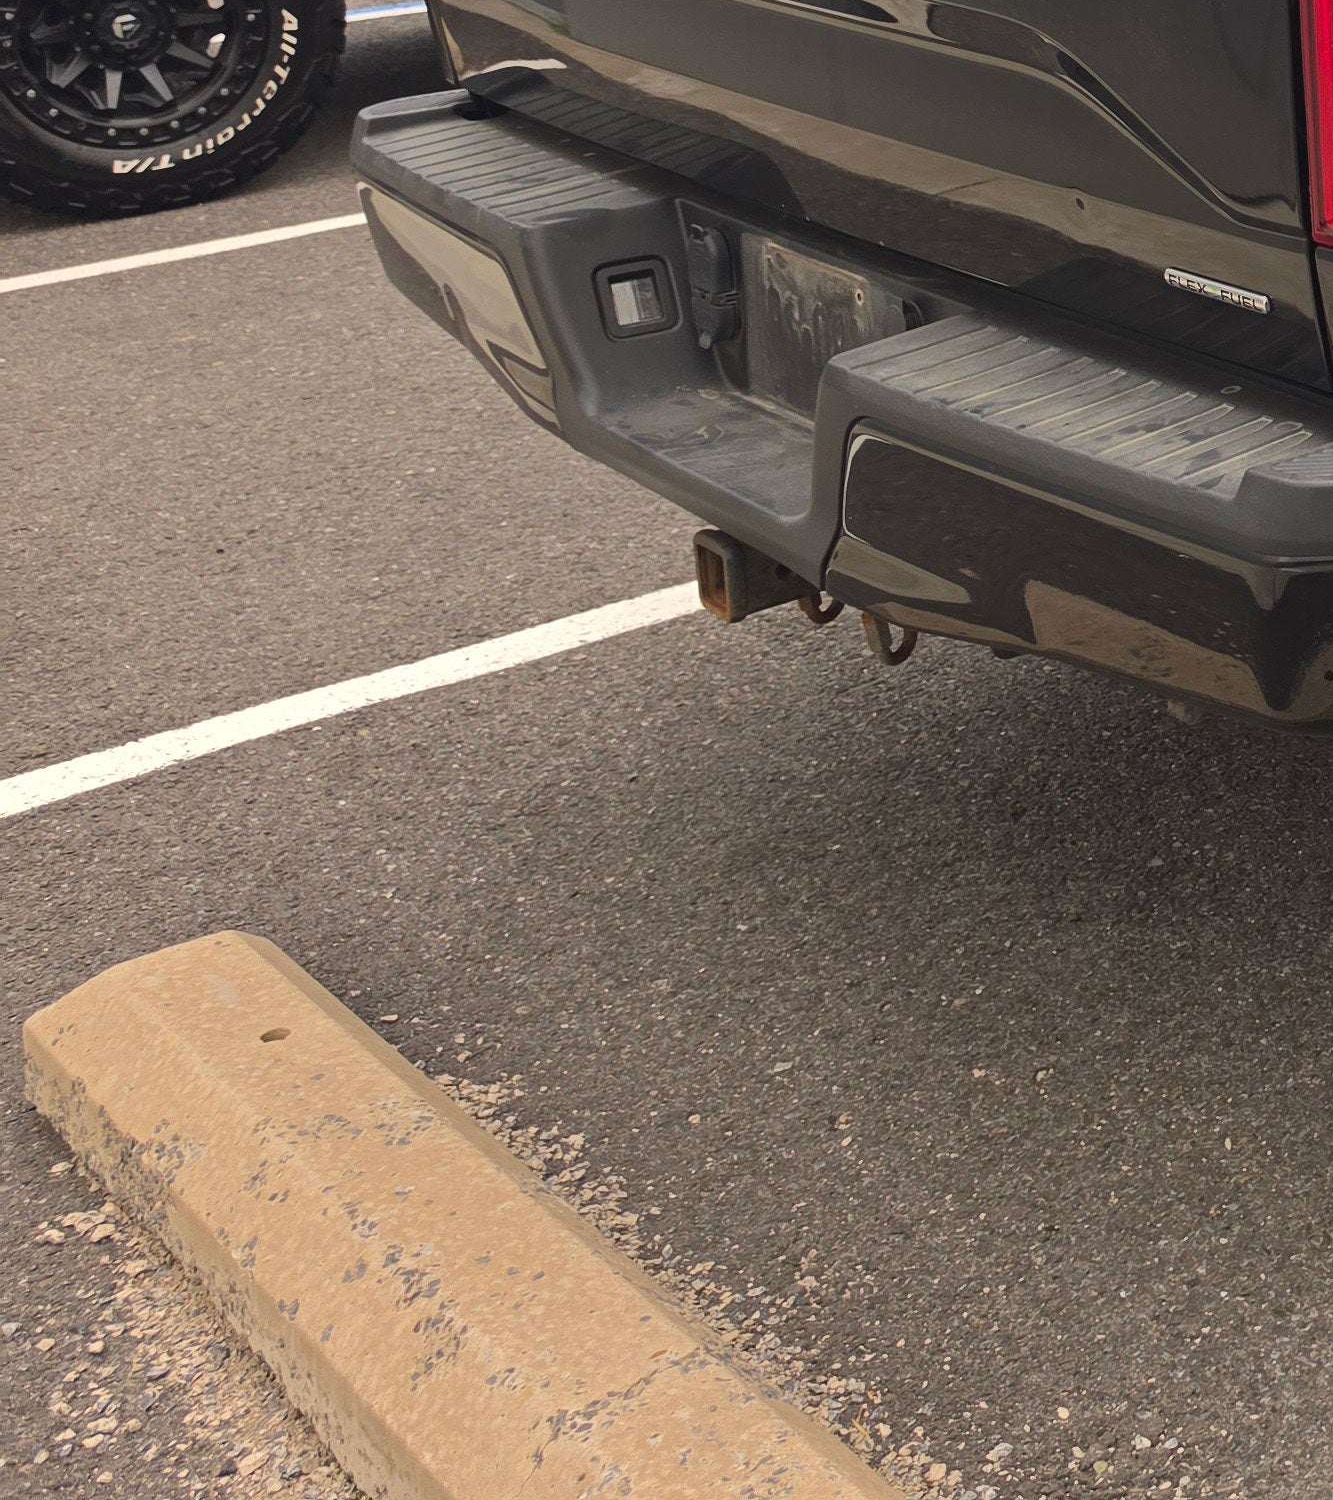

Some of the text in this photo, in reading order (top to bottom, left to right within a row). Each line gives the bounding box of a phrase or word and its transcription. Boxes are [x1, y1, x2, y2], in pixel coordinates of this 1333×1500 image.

[112, 153, 176, 174] T/A
[1167, 273, 1264, 312] FLEX FUEL
